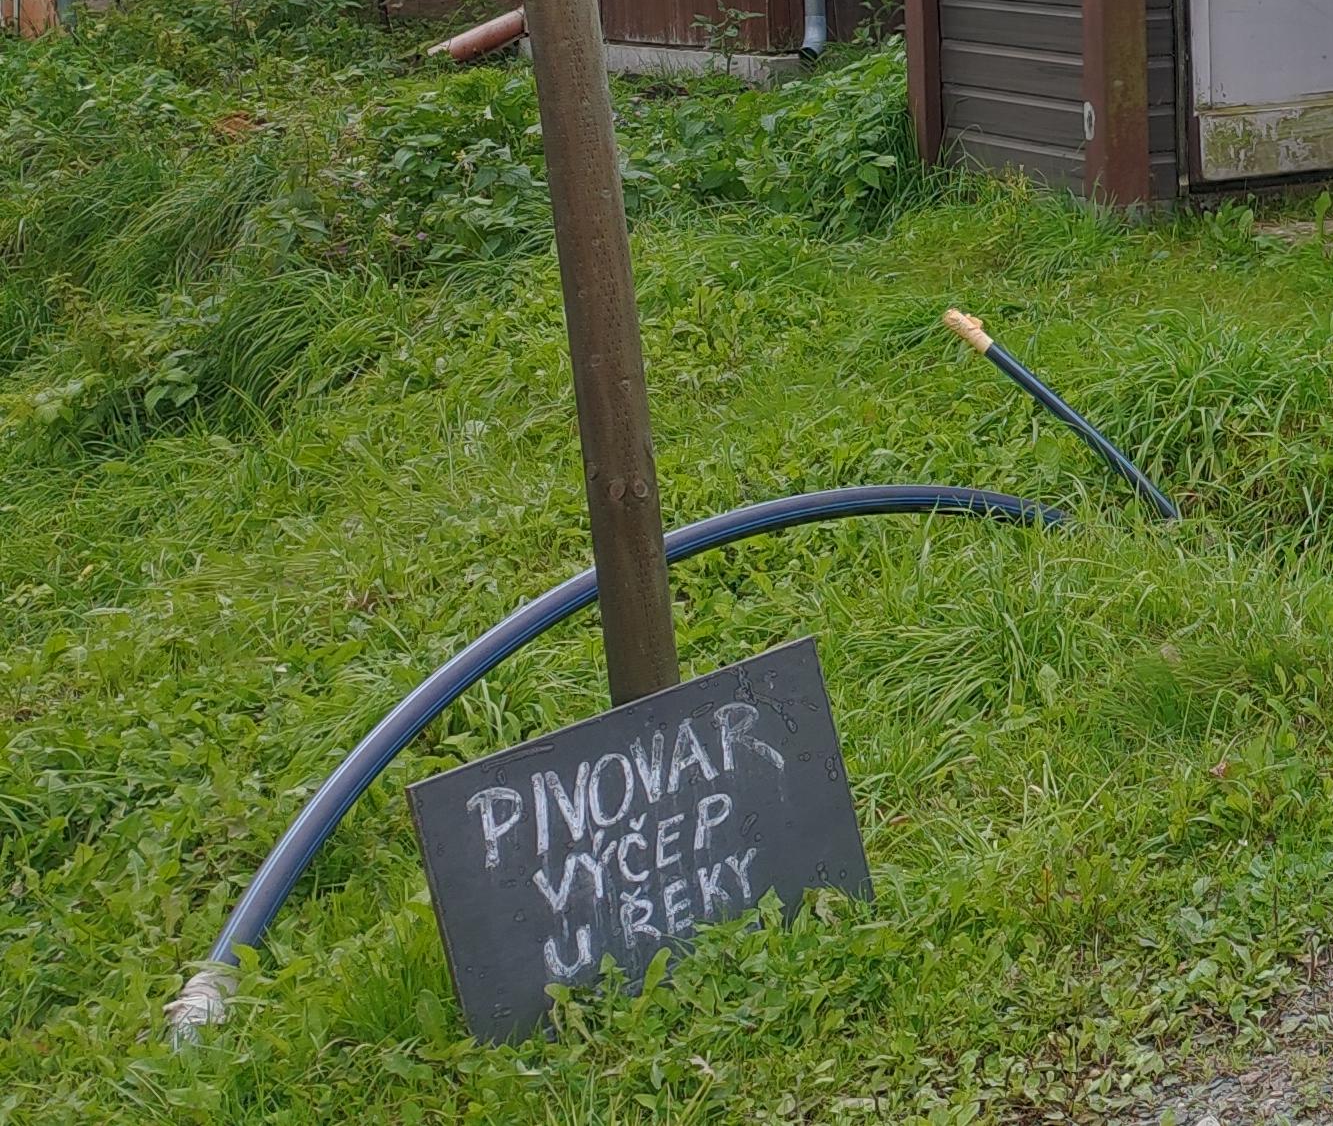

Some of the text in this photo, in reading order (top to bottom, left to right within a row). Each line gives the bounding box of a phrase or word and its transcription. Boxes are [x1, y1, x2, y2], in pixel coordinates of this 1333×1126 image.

[466, 702, 785, 868] PIVOVAR
[543, 847, 757, 977] U ŘEKY
